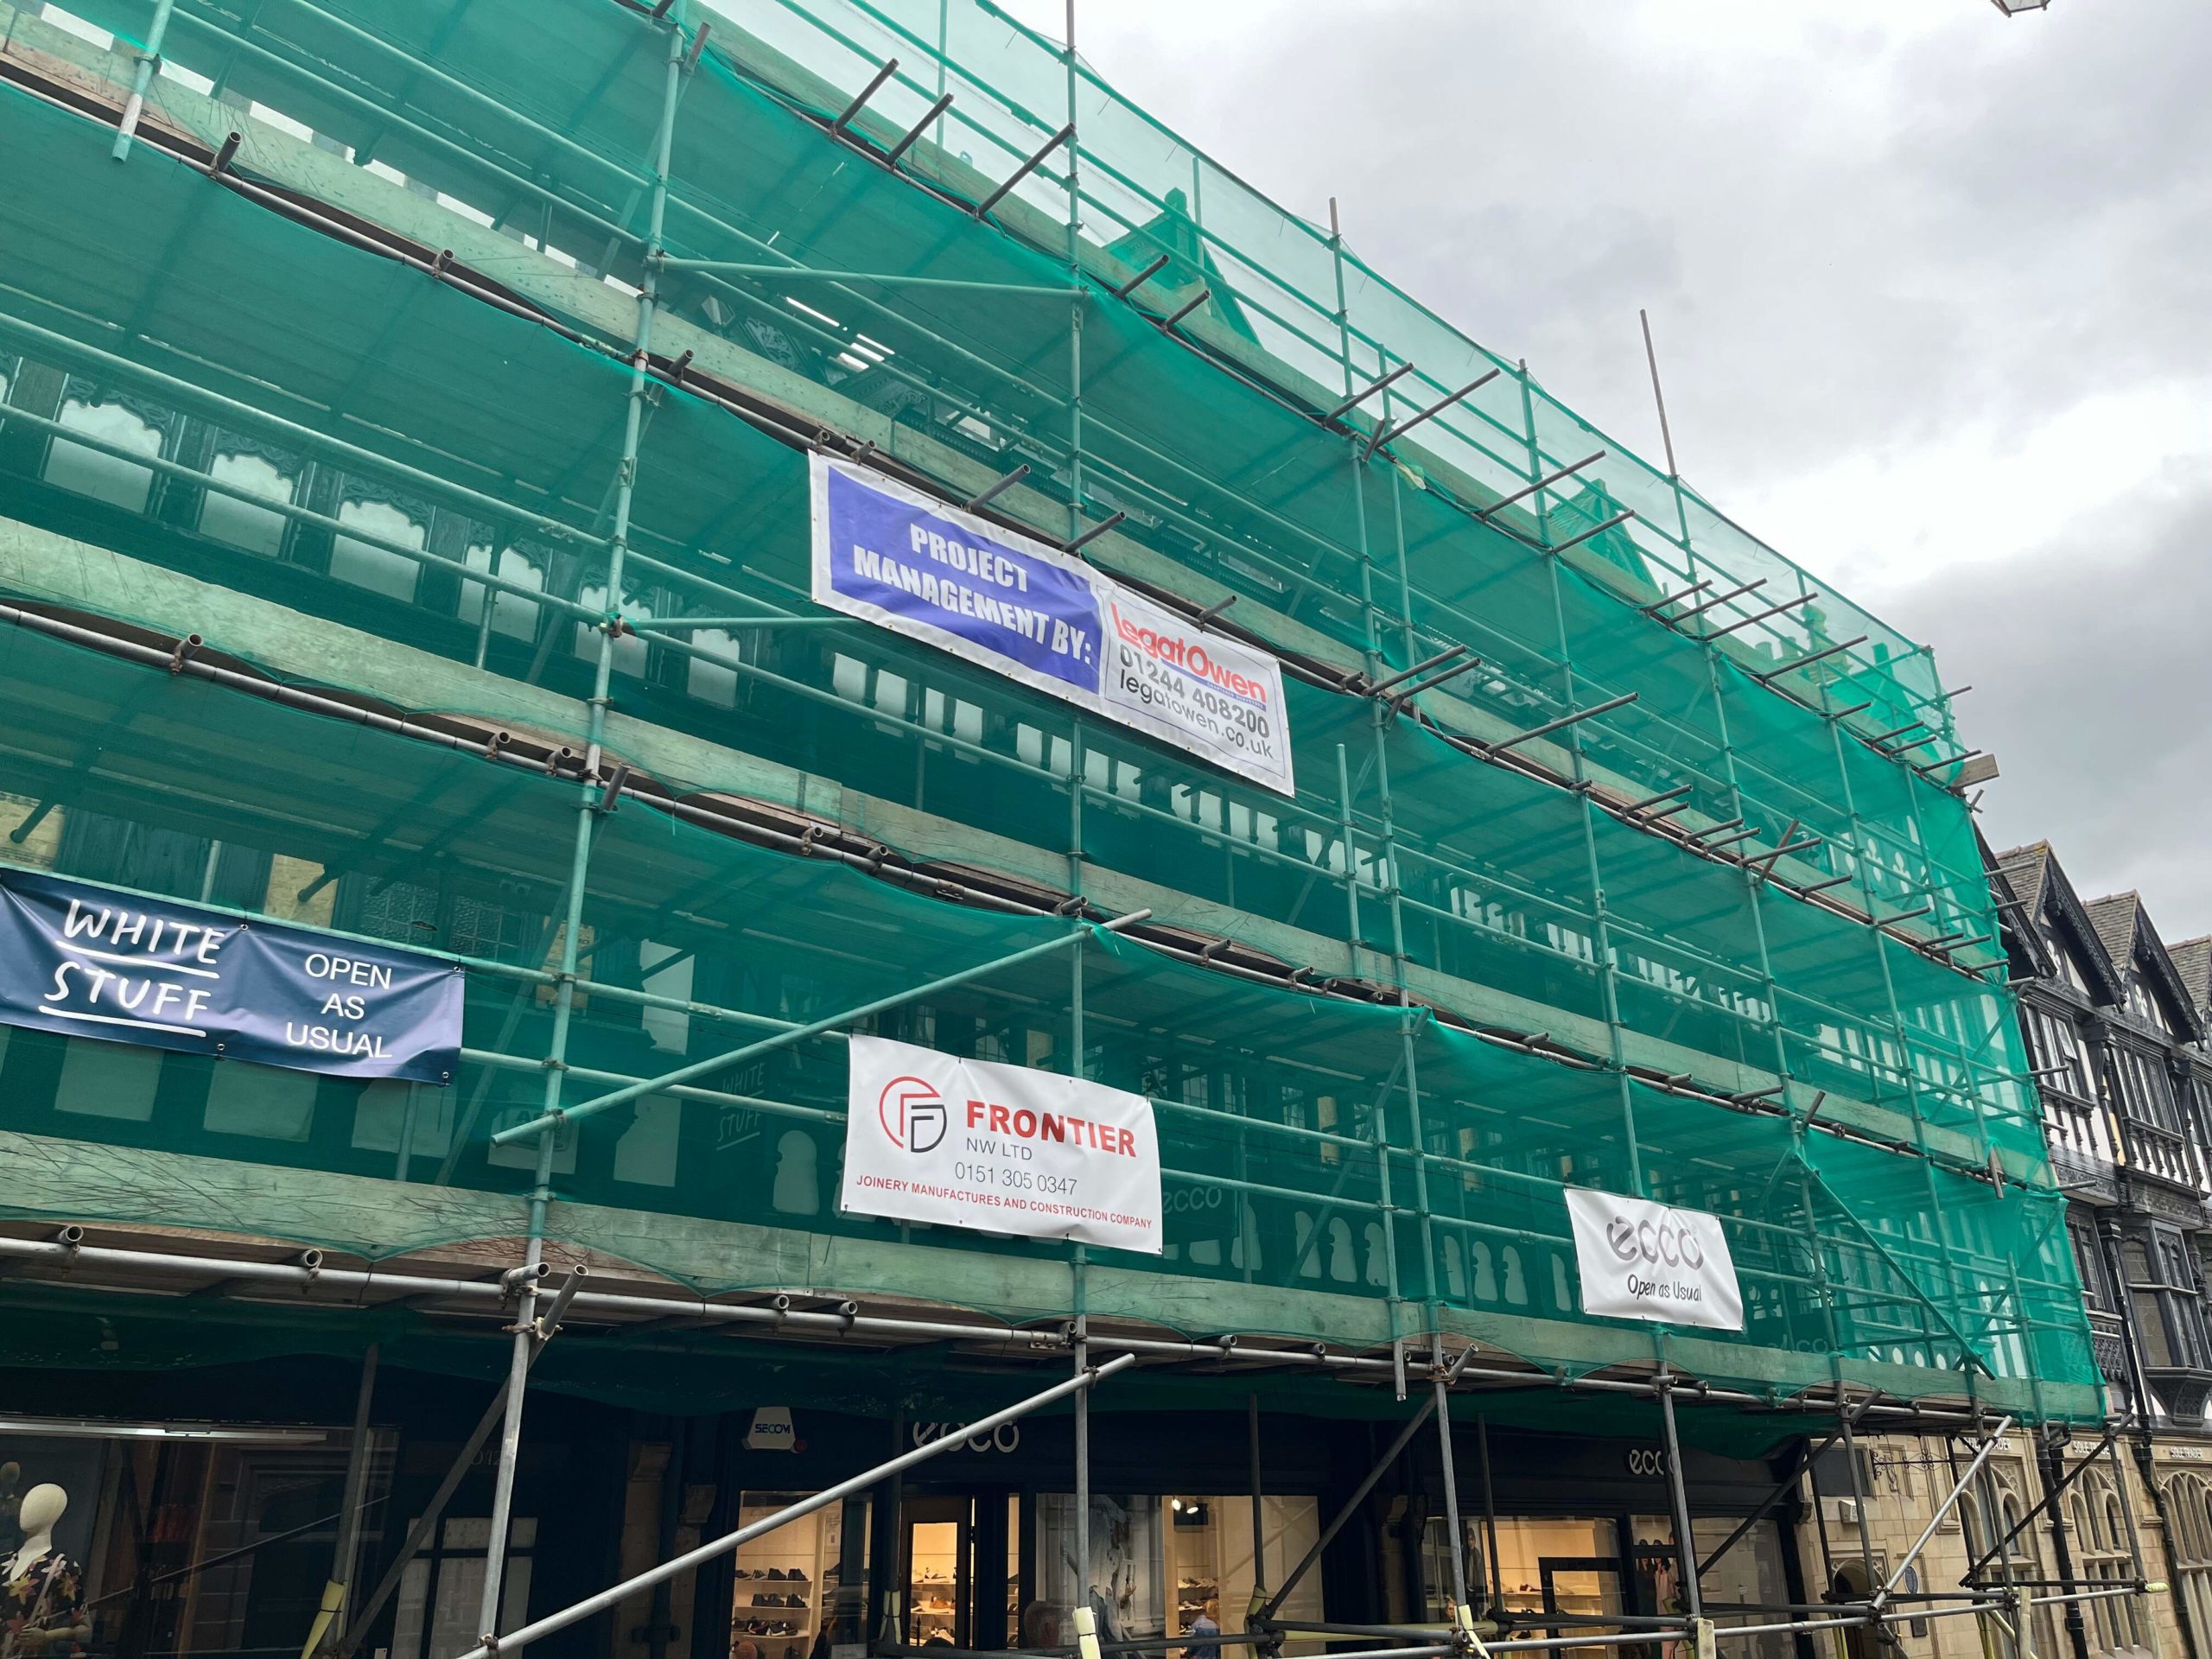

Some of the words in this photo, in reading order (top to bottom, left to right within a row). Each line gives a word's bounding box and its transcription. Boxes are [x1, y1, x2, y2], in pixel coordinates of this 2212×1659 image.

[910, 523, 1030, 593] PROJECT
[853, 544, 1051, 639] MANAGEMENT
[1052, 620, 1092, 665] BY:
[1120, 644, 1185, 698] 01244
[1192, 687, 1270, 739] 408200
[1120, 669, 1274, 760] legatowen.co.uk
[63, 899, 226, 965] WHITE
[45, 961, 212, 1021] STUFF
[304, 953, 391, 990] OPEN
[321, 993, 365, 1020] AS
[286, 1021, 392, 1058] USUAL
[722, 1062, 765, 1094] WHITE
[716, 1109, 761, 1143] STUFF
[966, 1100, 1137, 1158] FRONTIER
[966, 1137, 996, 1156] NW
[1002, 1141, 1033, 1161] LTD
[954, 1160, 996, 1185] 0151
[1001, 1169, 1033, 1190] 305
[1037, 1173, 1077, 1196] 0347
[856, 1174, 909, 1193] JOINERY
[911, 1184, 1001, 1206] MANUFACTURES
[1003, 1197, 1027, 1210] AND
[1030, 1202, 1109, 1223] CONSTRUCTION
[1109, 1213, 1153, 1230] COMPANY
[1605, 1215, 1705, 1271] ecco
[1627, 1274, 1656, 1301] Open
[1658, 1284, 1670, 1299] as
[1673, 1281, 1702, 1302] Usual
[754, 1423, 791, 1434] SECOM
